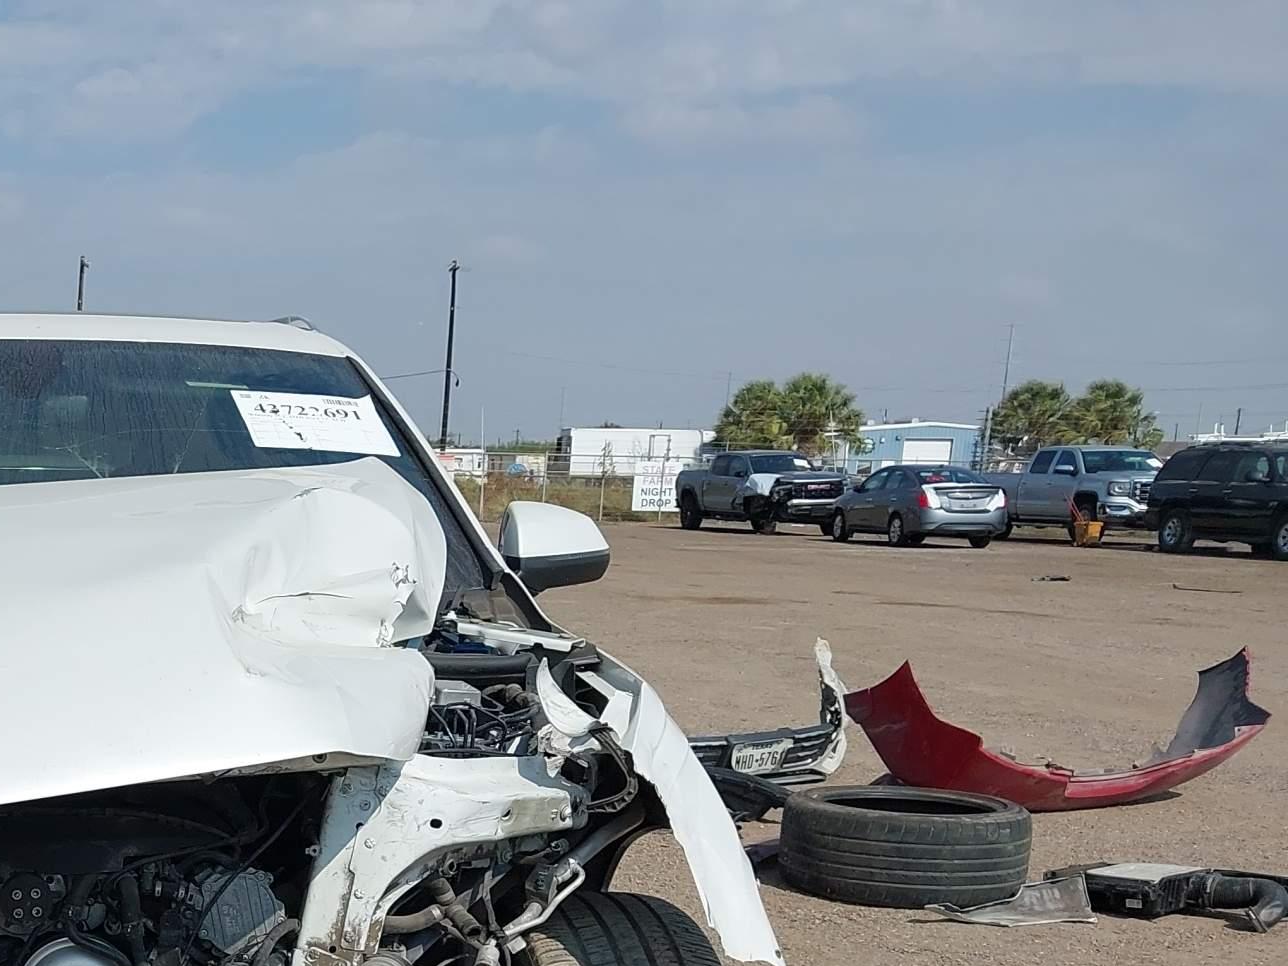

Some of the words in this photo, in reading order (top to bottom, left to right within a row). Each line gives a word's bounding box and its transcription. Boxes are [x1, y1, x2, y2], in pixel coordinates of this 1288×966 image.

[642, 465, 676, 474] STATE
[642, 477, 673, 487] FARM
[640, 487, 674, 497] NIGHT
[640, 498, 672, 508] DROP
